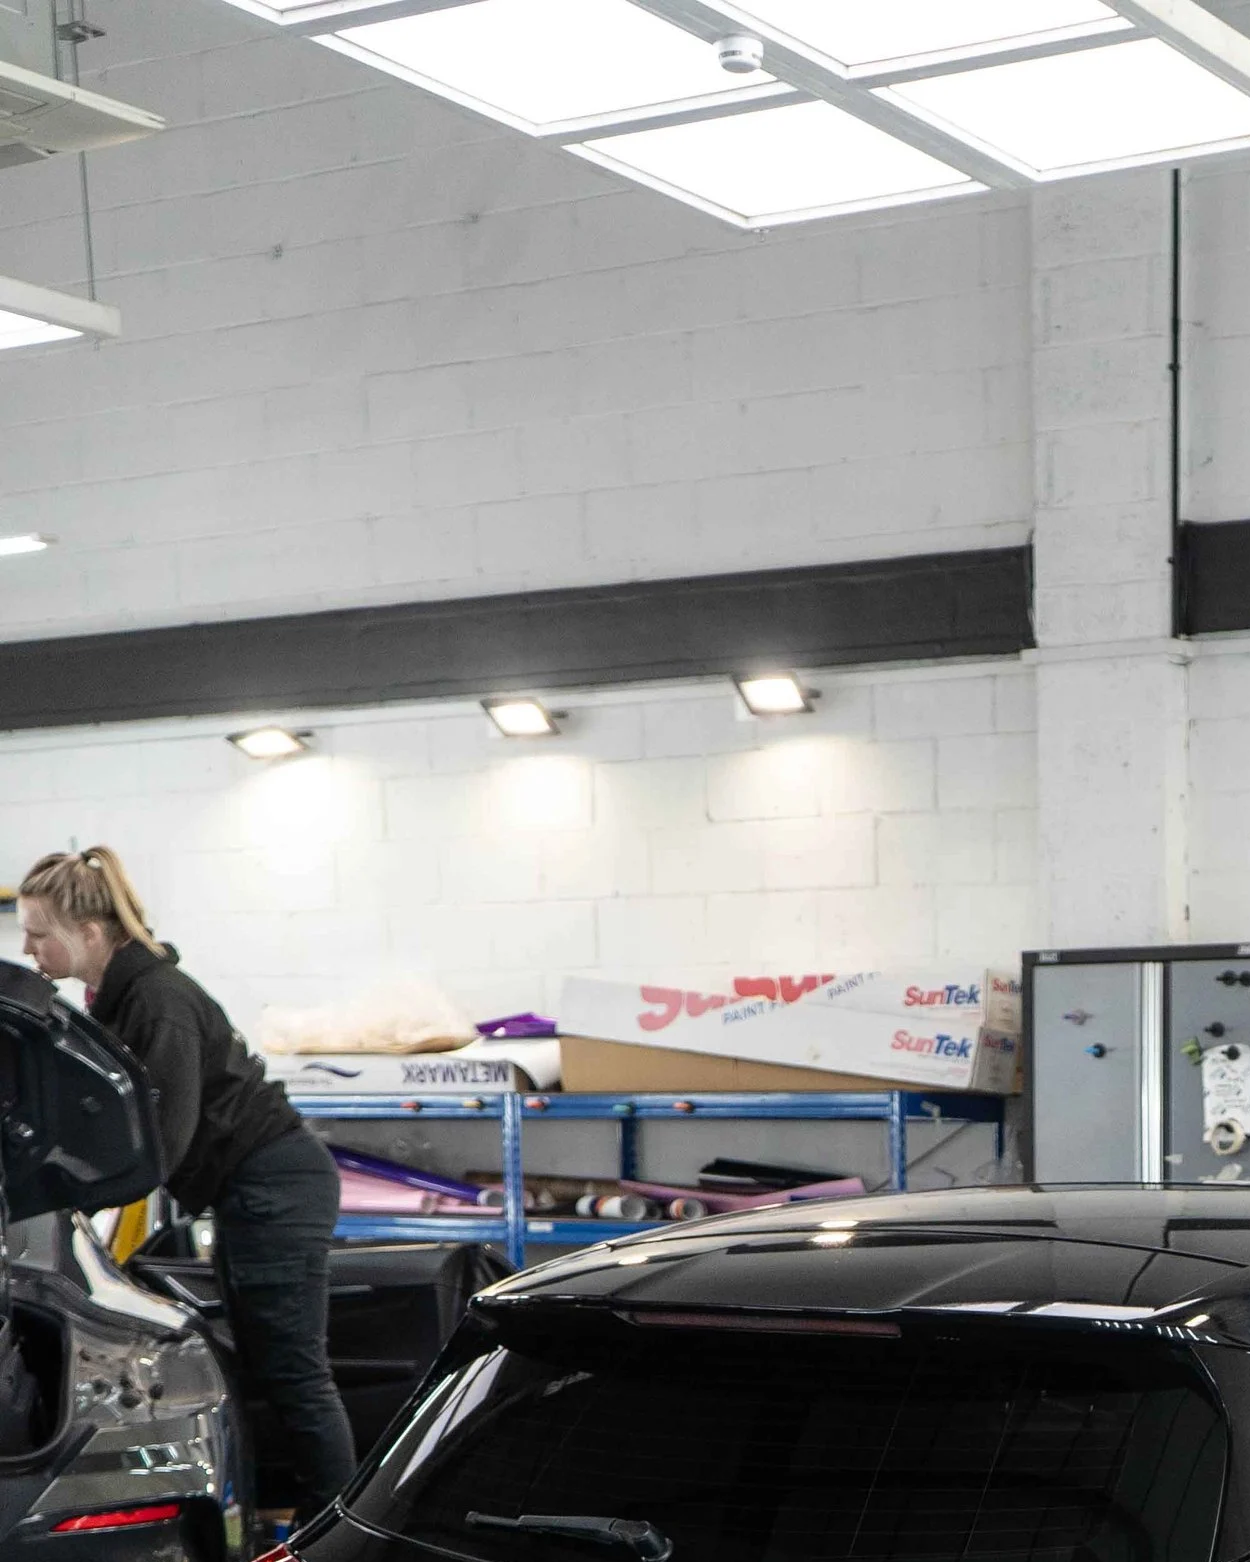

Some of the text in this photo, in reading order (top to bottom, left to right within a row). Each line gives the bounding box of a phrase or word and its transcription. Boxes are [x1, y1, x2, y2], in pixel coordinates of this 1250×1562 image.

[904, 984, 980, 1006] SunTek
[891, 1029, 971, 1058] SunTek
[401, 1061, 509, 1083] METAMARK
